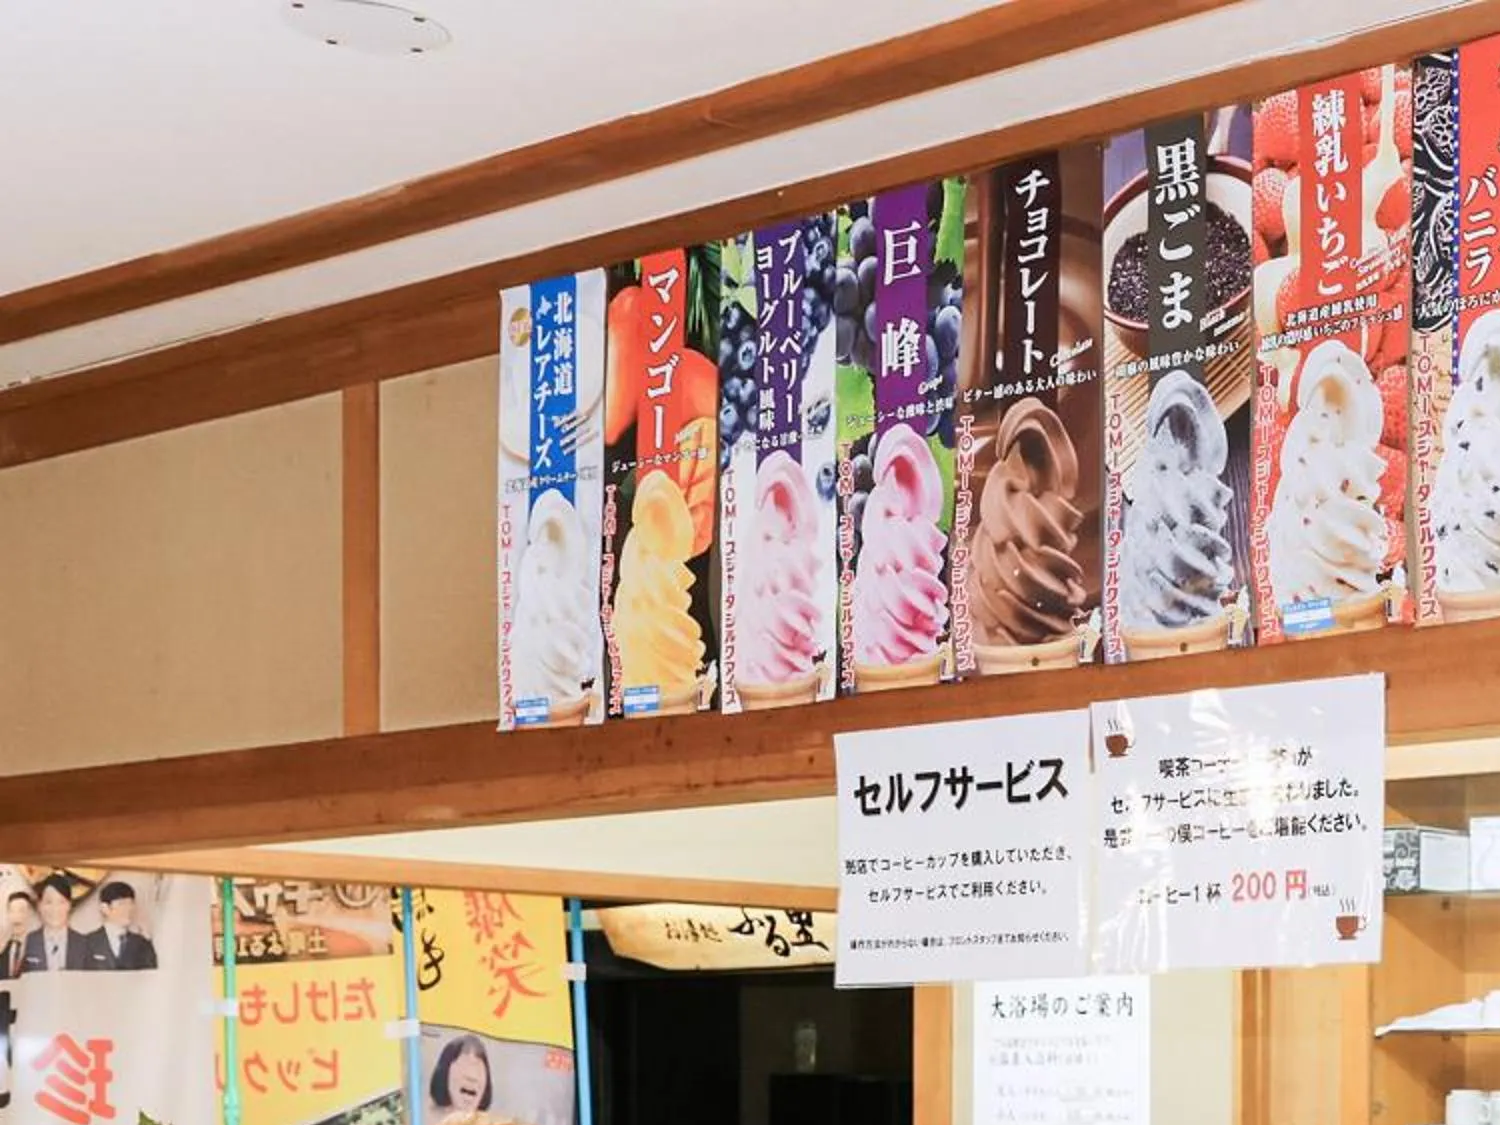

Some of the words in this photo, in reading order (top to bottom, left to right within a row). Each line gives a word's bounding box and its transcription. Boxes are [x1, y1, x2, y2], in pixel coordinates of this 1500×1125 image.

[1155, 138, 1200, 331] 黒ごま
[1311, 88, 1350, 296] 練乳いちご
[1462, 167, 1500, 290] バニラ
[779, 229, 802, 424] ブルーベリー
[881, 222, 923, 379] 巨峰
[1015, 169, 1051, 375] チョコレート
[534, 325, 553, 471] レアチーズ
[553, 292, 574, 396] 北海道
[647, 269, 679, 450] マンゴー
[756, 246, 776, 432] ヨーグルト風味
[1417, 334, 1434, 415] TOMI
[956, 415, 975, 489] TOMI
[1108, 393, 1123, 466] TOMI
[1258, 365, 1275, 443] TOMI
[853, 757, 1069, 818] セルフサービス
[868, 880, 1048, 904] セルフサービスでご利用ください。
[991, 991, 1134, 1020] 大浴場のご案内
